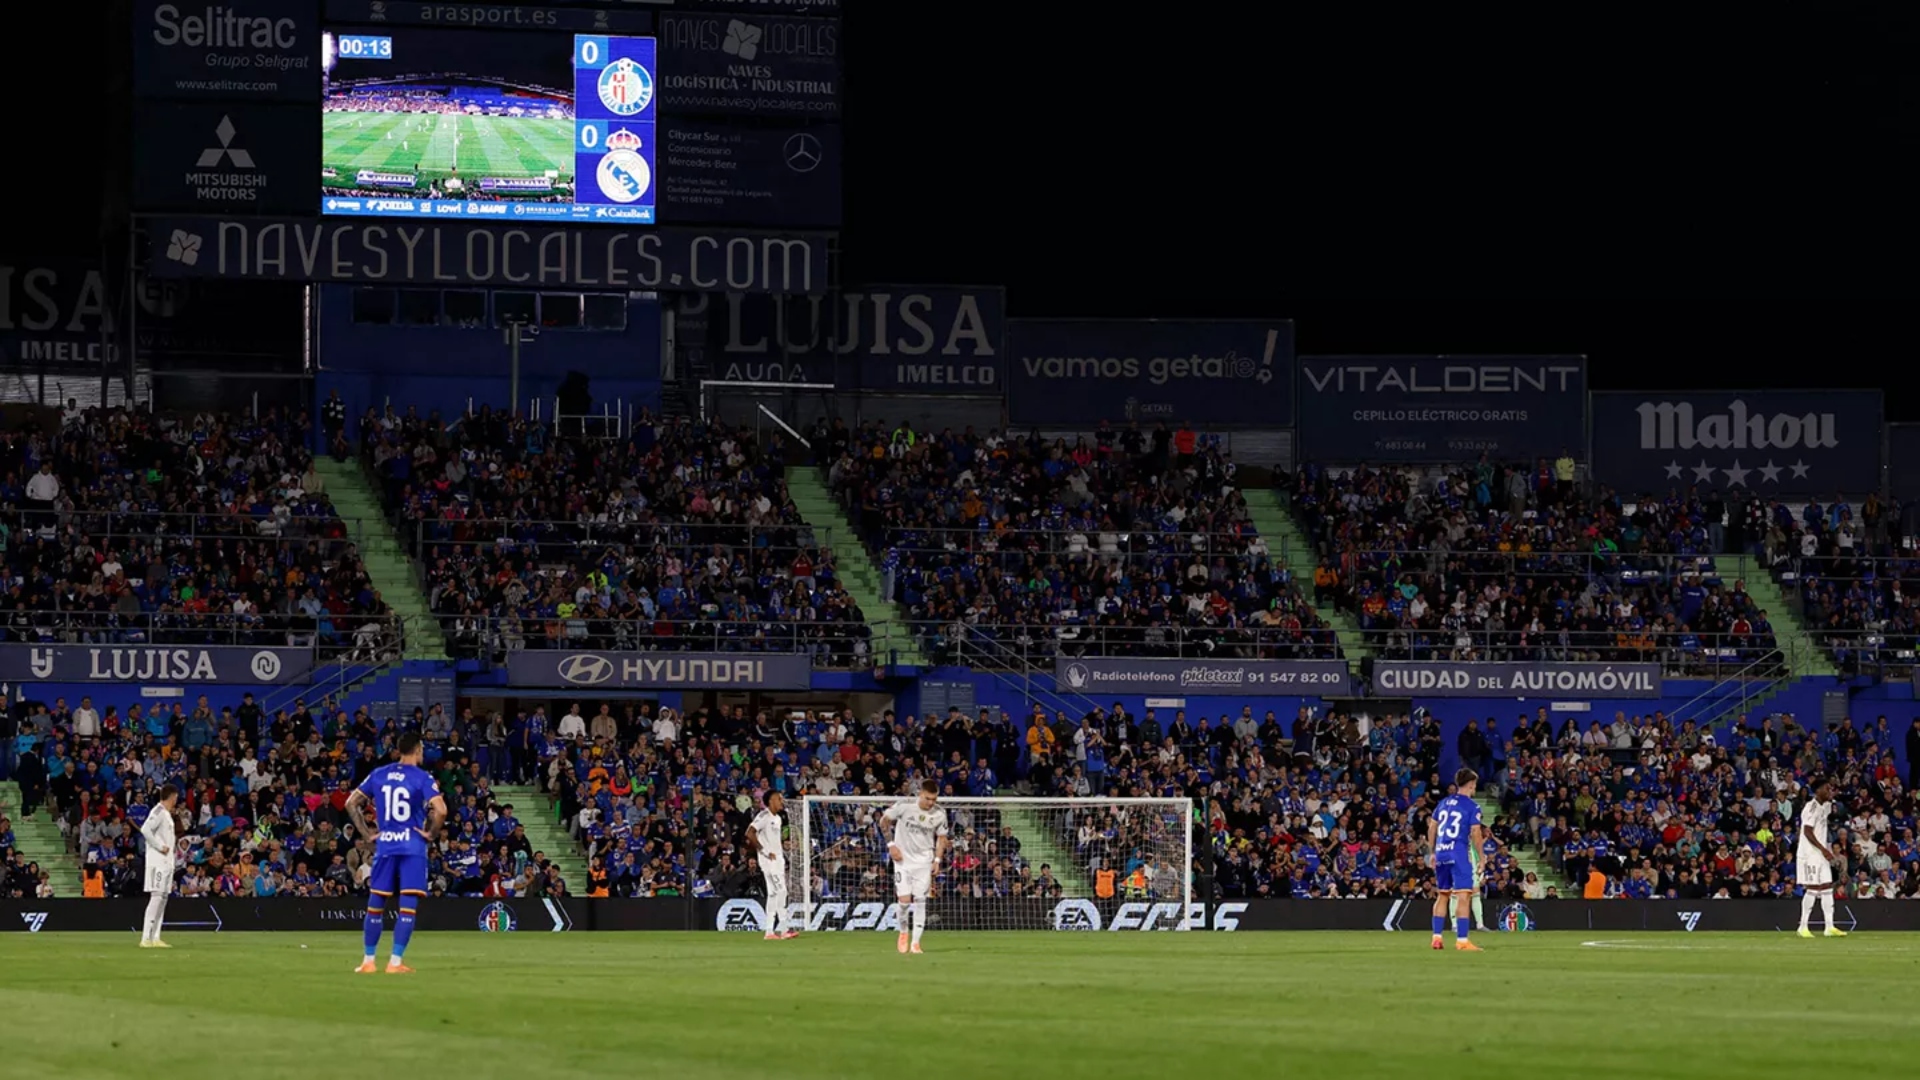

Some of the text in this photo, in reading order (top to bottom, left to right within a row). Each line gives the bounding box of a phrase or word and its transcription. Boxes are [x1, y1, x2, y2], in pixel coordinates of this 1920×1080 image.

[420, 5, 557, 25] arasport.es
[153, 4, 296, 49] Selitrac
[339, 38, 391, 56] 00:13
[581, 41, 598, 64] 0
[205, 53, 308, 70] Grupo Seligrat
[727, 65, 772, 78] NAVES
[175, 79, 277, 91] www.selitrac.com
[665, 73, 739, 90] LOGÍSTICA
[752, 79, 836, 94] INDUSTRIAL
[665, 95, 836, 111] www.navesylocales.com
[581, 125, 598, 148] 0
[668, 129, 702, 141] Citycar
[185, 172, 267, 187] MITSUBISHI
[197, 187, 256, 200] MOTORS
[608, 207, 650, 218] CaixaBank
[724, 293, 995, 357] LUJISA
[21, 341, 119, 362] IMELCO
[897, 364, 995, 385] IMELCO
[1022, 356, 1139, 378] vamos
[1304, 366, 1579, 392] VITALDENT
[1353, 407, 1528, 421] CEPILLO ELÉCTRICO GRATIS
[1634, 400, 1839, 449] Mahou
[89, 649, 217, 680] LUJISA
[623, 658, 764, 683] HYUNDAI
[1093, 667, 1340, 686] Radioteléfono pidetaxi 91 547 82 00
[1380, 667, 1654, 690] CIUDAD DEL AUTOMÓVIL
[381, 785, 410, 822] 16
[1437, 810, 1462, 838] 23
[726, 907, 758, 924] EA
[1060, 907, 1092, 924] EA
